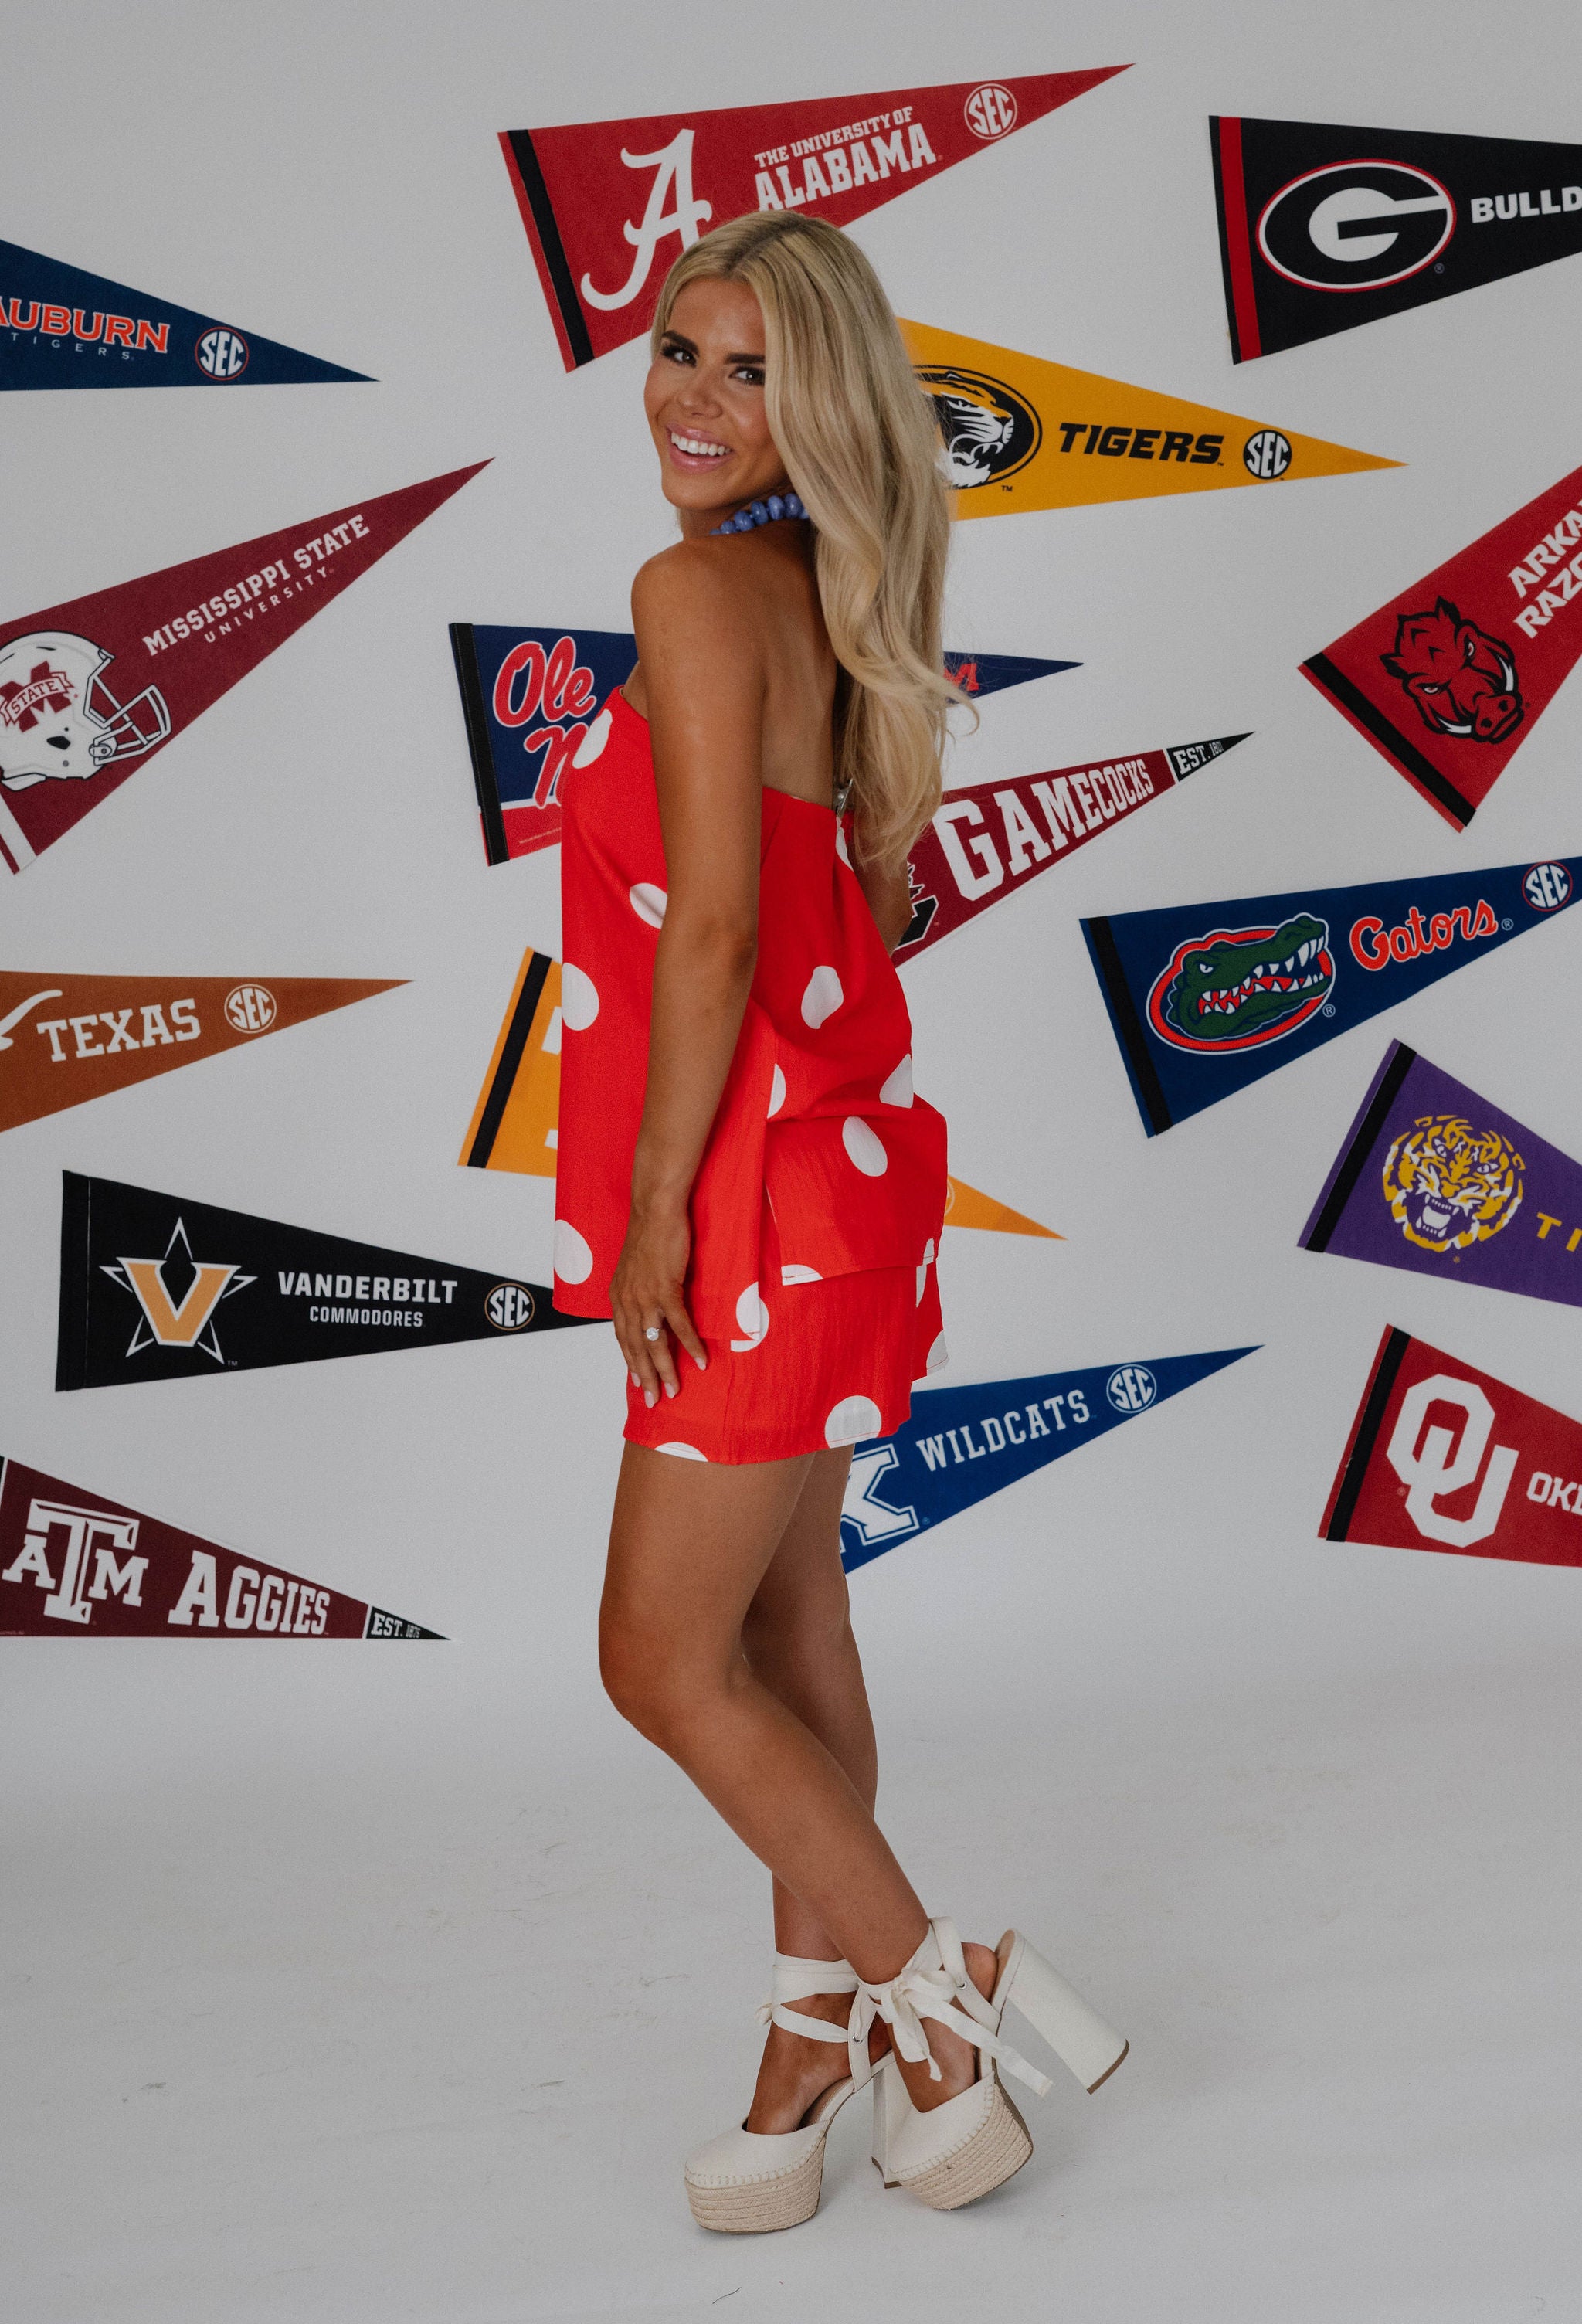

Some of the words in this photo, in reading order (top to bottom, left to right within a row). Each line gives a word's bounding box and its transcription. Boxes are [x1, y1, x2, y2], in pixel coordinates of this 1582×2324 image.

[754, 145, 789, 168] THE
[790, 113, 891, 158] UNIVERSITY
[892, 106, 913, 126] OF
[969, 87, 1014, 136] SEC
[755, 123, 937, 212] ALABAMA
[1470, 186, 1582, 223] BULLD
[1309, 187, 1448, 262] G
[11, 332, 130, 360] TIGERS
[200, 331, 245, 376] SEC
[1058, 423, 1224, 465] TIGERS
[1246, 433, 1288, 477] SEC
[142, 559, 291, 656] MISSISSIPPI
[294, 514, 370, 569] STATE
[1508, 500, 1582, 599] ARKA
[204, 566, 329, 643] UNIVERSITY
[11, 681, 59, 714] STATE
[492, 636, 596, 728] Ole
[932, 759, 1155, 902] GAMECOCKS
[1173, 745, 1211, 775] EST.
[1349, 899, 1499, 971] Gators
[1526, 862, 1569, 908] SEC
[36, 999, 202, 1062] TEXAS
[229, 988, 273, 1029] SEC
[116, 1257, 242, 1347] V
[278, 1271, 458, 1305] VANDERBILT
[487, 1286, 531, 1328] SEC
[308, 1306, 423, 1328] COMMODORES
[916, 1389, 1090, 1472] WILDCATS
[1110, 1368, 1153, 1411] SEC
[1387, 1374, 1519, 1548] OU
[168, 1550, 330, 1636] AGGIES
[371, 1612, 403, 1637] EST.
